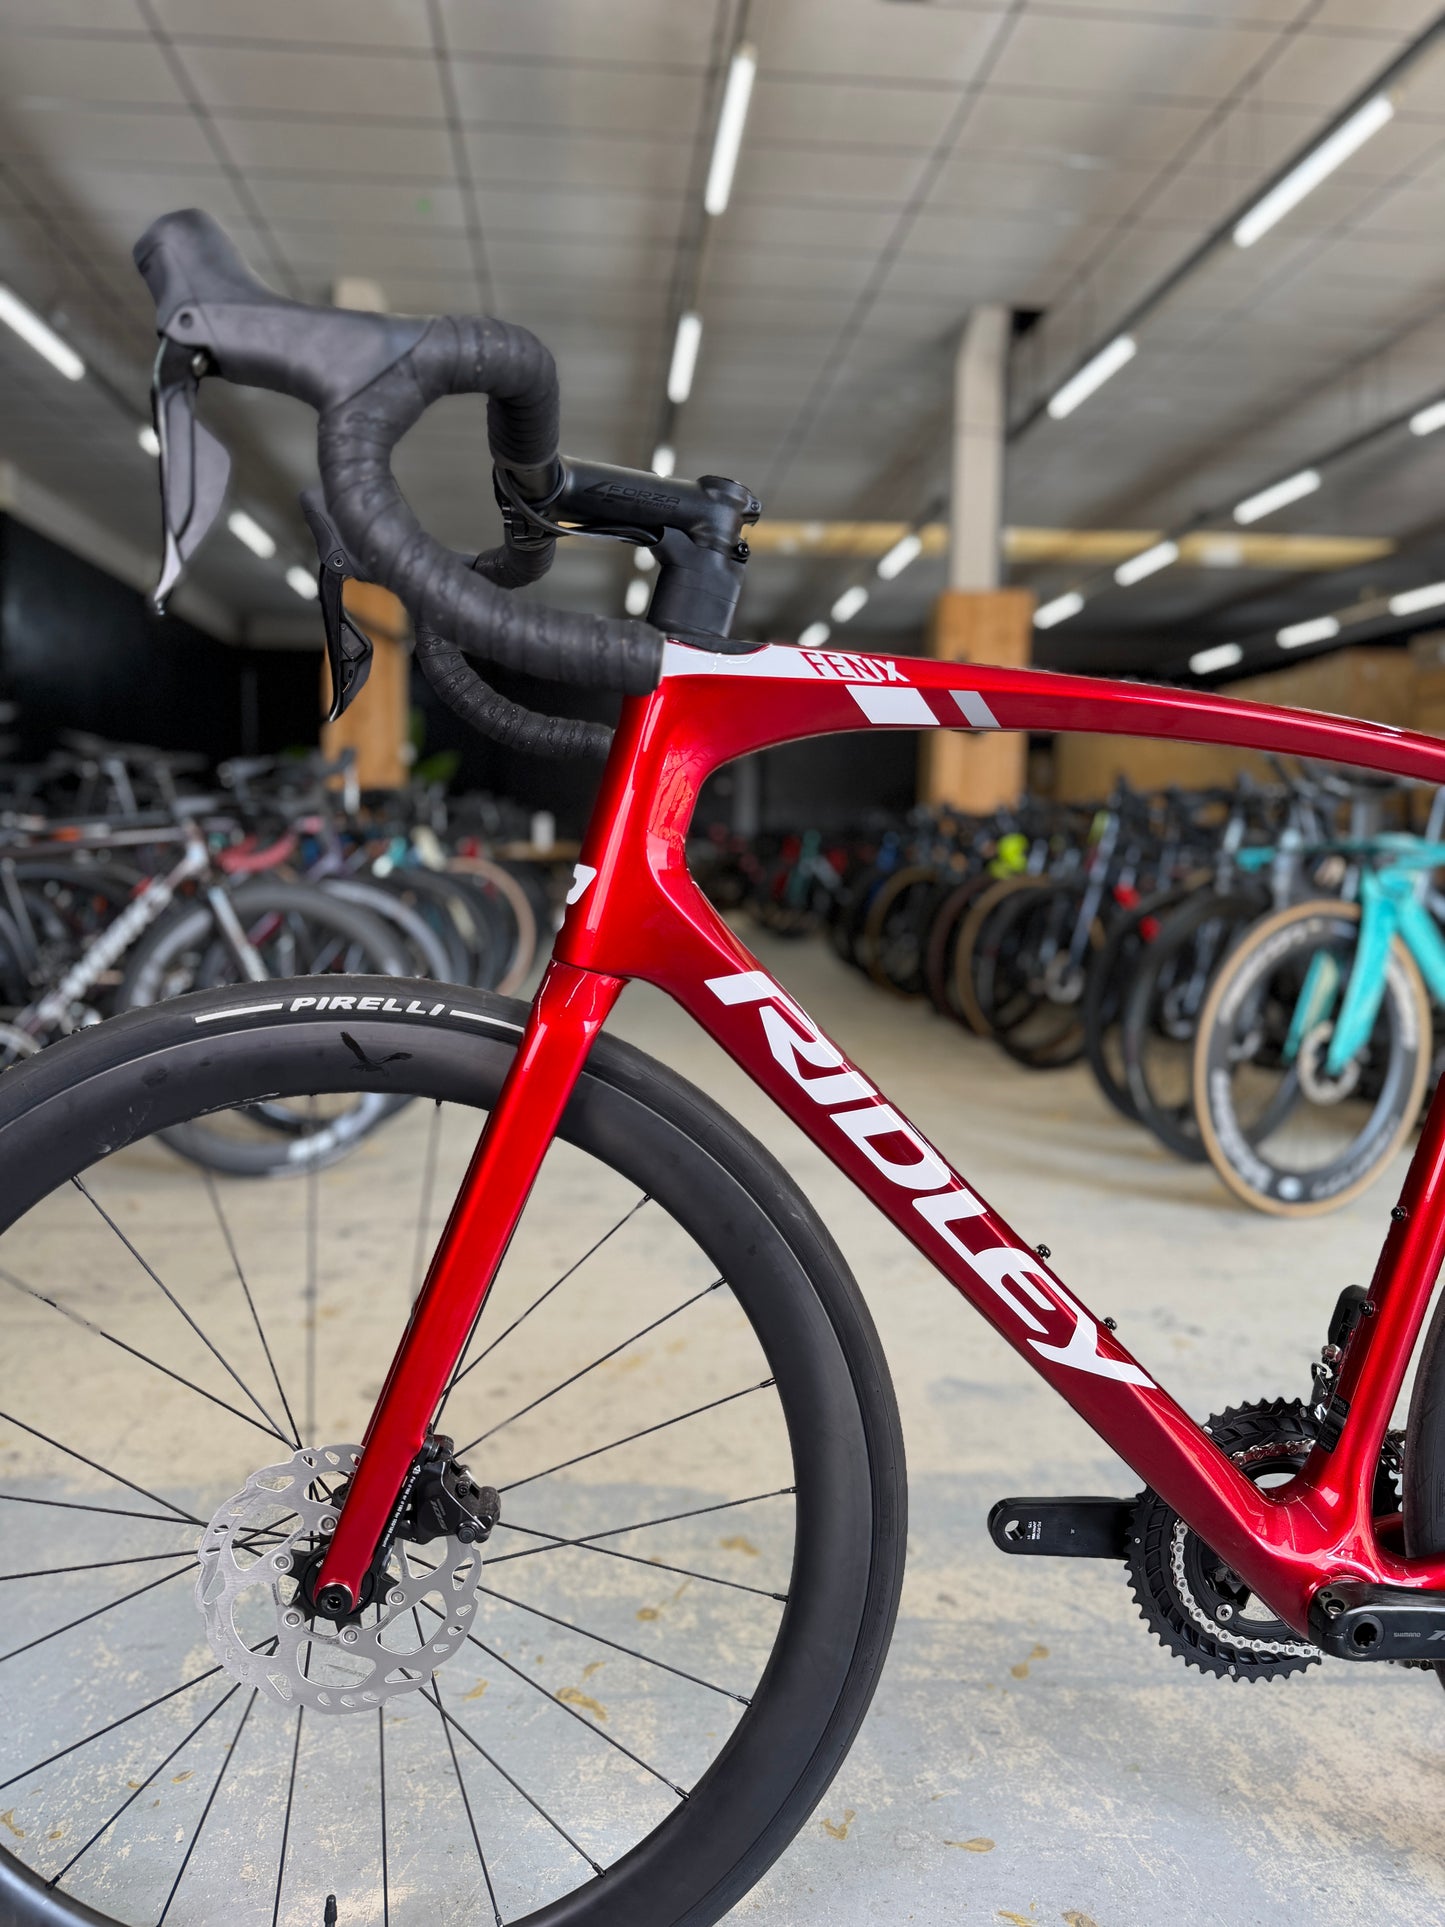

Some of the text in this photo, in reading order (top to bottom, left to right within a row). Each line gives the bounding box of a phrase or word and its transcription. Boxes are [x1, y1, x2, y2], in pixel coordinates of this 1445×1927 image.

[608, 485, 681, 505] FORZA
[799, 651, 911, 682] FENIX
[289, 996, 446, 1016] PIRELLI
[704, 970, 1157, 1390] RIDLEY
